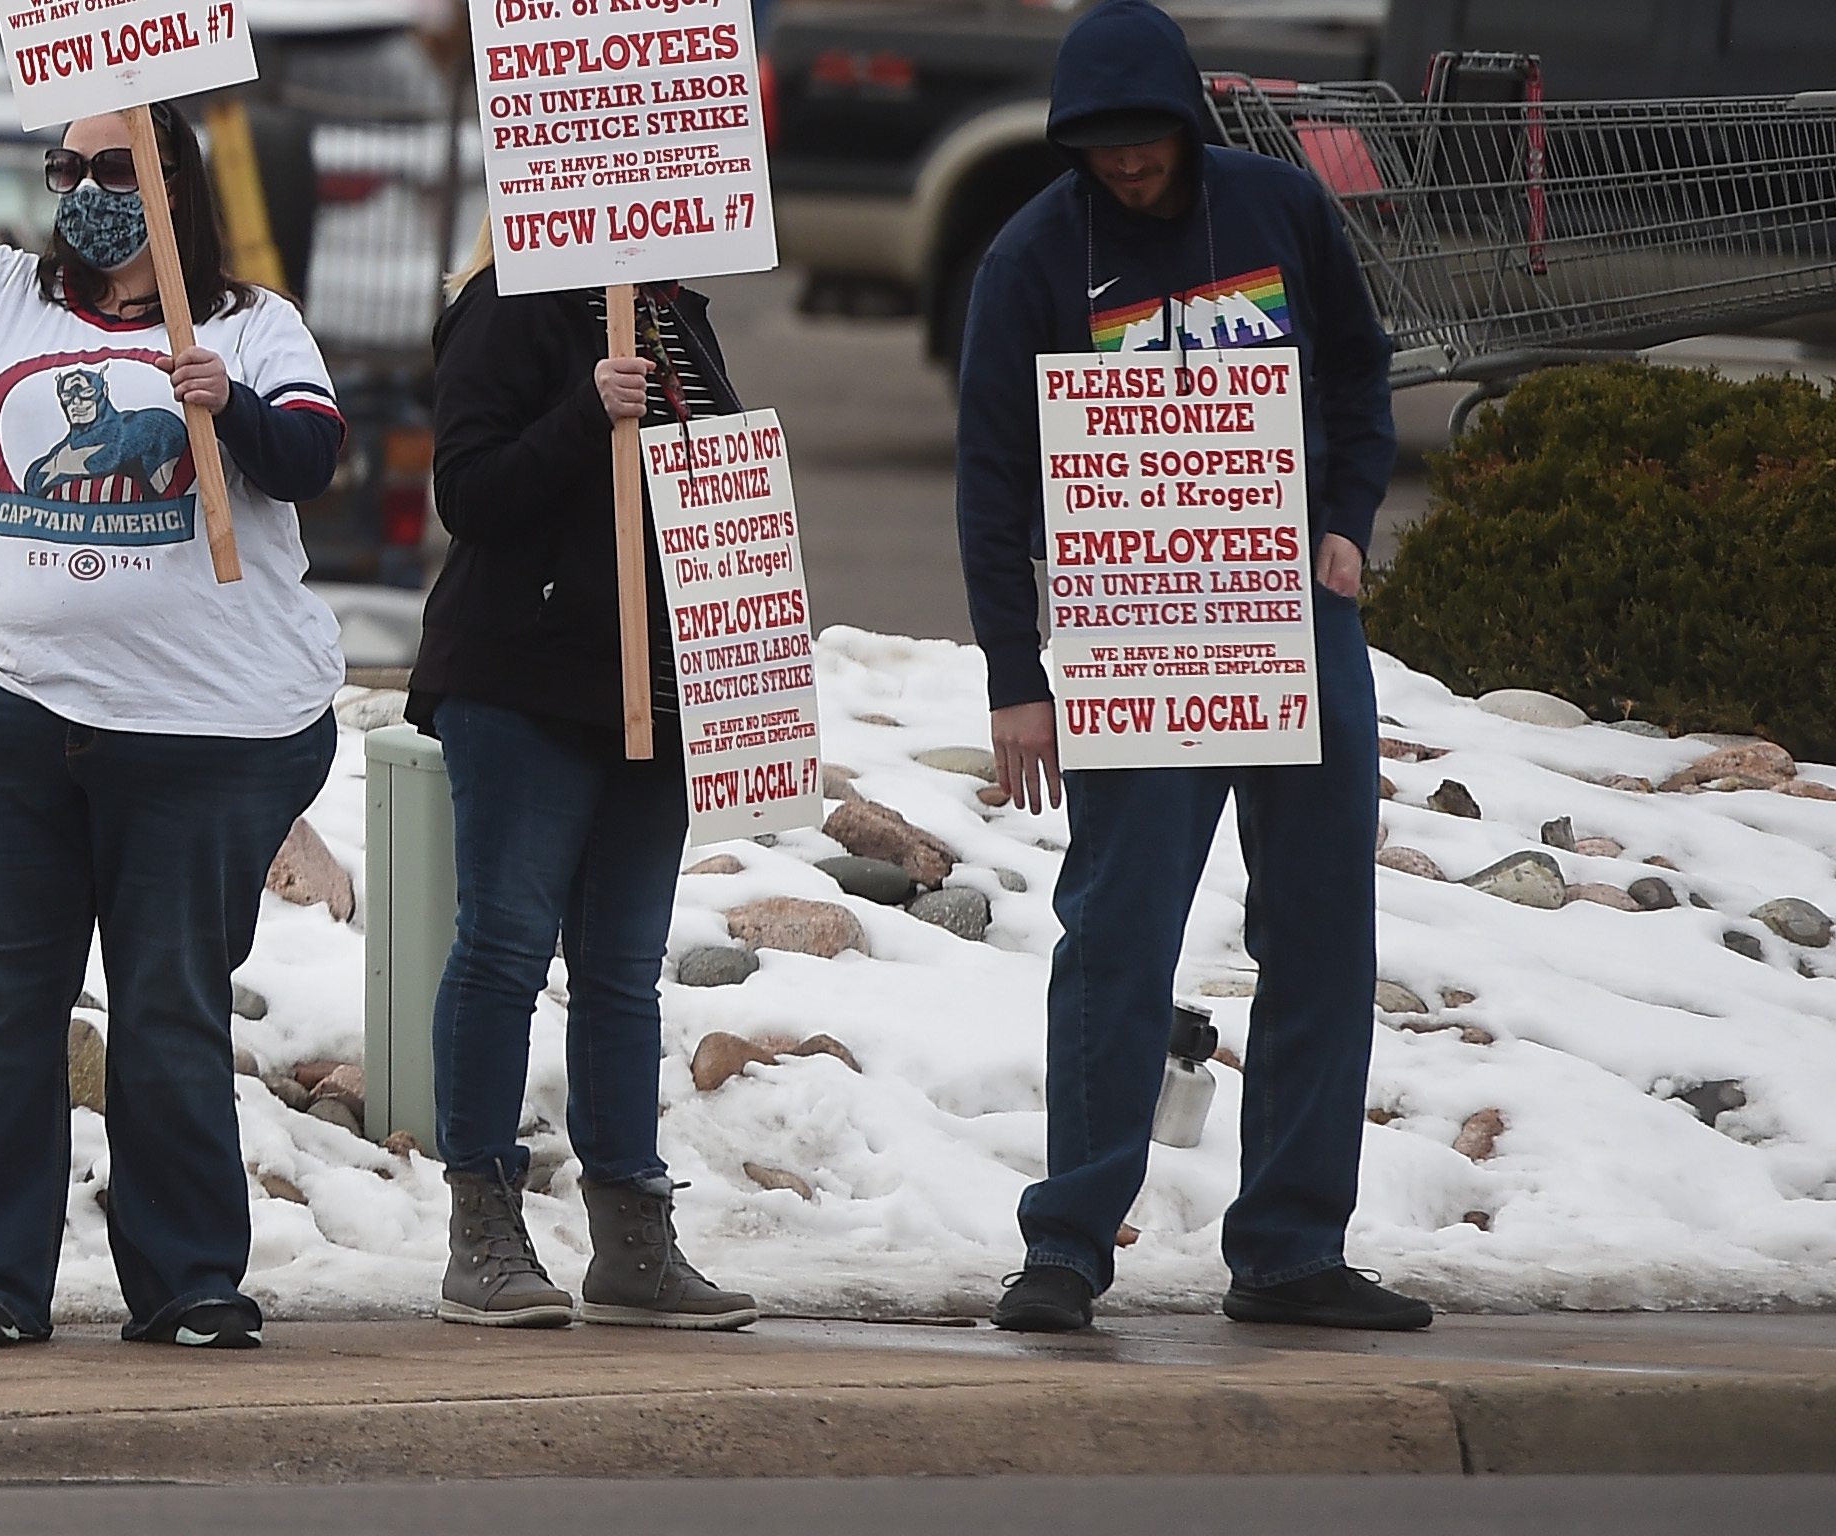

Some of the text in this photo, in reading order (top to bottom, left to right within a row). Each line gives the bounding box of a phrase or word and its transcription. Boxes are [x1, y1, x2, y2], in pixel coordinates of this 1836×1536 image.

[9, 9, 46, 28] WITH
[50, 0, 79, 20] ANY
[16, 2, 234, 86] UFCW LOCAL #7
[486, 23, 739, 82] EMPLOYEES
[490, 73, 748, 118] ON UNFAIR LABOR
[495, 104, 748, 149] PRACTICE STRIKE
[500, 157, 750, 194] WITH ANY OTHER EMPLOYER
[529, 144, 718, 175] WE HAVE NO DISPUTE
[503, 192, 755, 251] UFCW LOCAL #7
[1045, 364, 1290, 400] PLEASE DO NOT
[1085, 402, 1255, 436] PATRONIZE
[724, 431, 749, 464] DO
[750, 426, 781, 460] NOT
[1049, 448, 1296, 480] KING SOOPER'S
[677, 466, 771, 509] PATRONIZE
[1065, 481, 1284, 512] (Div. of Kroger)
[662, 511, 795, 554] KING SOOPER'S
[1055, 525, 1300, 566] EMPLOYEES
[28, 551, 151, 571] EST. 1941
[676, 543, 792, 588] (Div. of Kroger)
[1052, 569, 1301, 597] ON UNFAIR LABOR
[675, 588, 805, 642] EMPLOYEES
[1056, 599, 1301, 627] PRACTICE STRIKE
[680, 634, 811, 674] ON UNFAIR LABOR
[1063, 659, 1306, 678] WITH ANY OTHER EMPLOYER
[1091, 643, 1276, 661] WE HAVE NO DISPUTE
[683, 664, 812, 704] PRACTICE STRIKE
[1065, 693, 1308, 736] UFCW LOCAL #7
[691, 757, 817, 812] UFCW LOCAL #7
